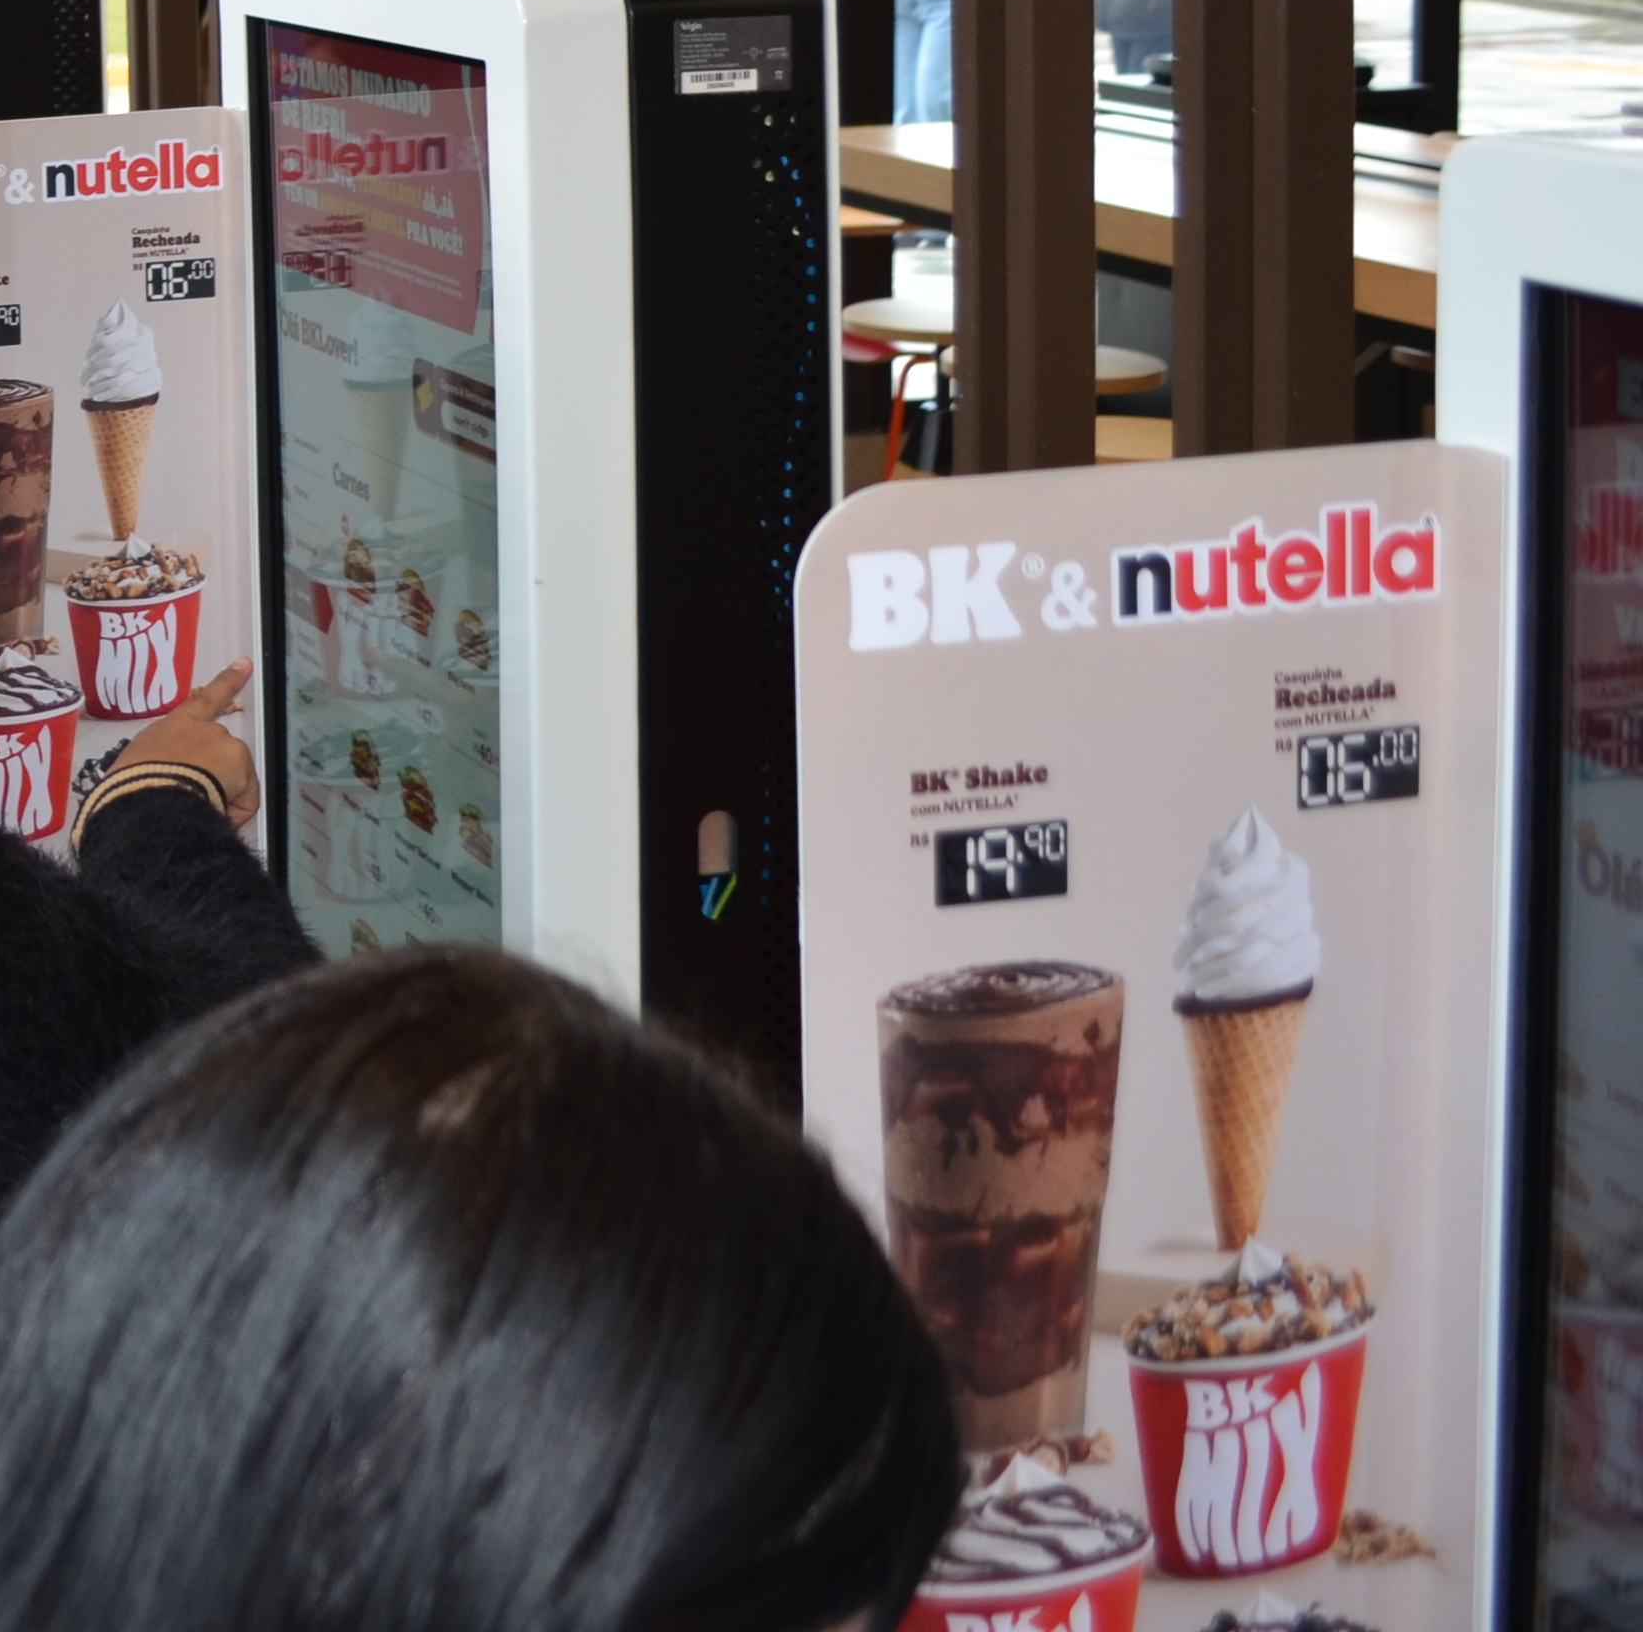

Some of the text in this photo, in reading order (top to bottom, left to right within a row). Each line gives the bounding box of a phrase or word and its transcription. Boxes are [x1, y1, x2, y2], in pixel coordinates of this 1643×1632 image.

[280, 53, 432, 118] ESTAMOS MUDANDO
[4, 167, 35, 206] &
[45, 141, 221, 200] nutella
[131, 232, 202, 249] Recheada
[147, 260, 214, 300] 06.00
[332, 463, 370, 501] Carnes
[847, 507, 1436, 652] BK & nutella
[98, 610, 154, 639] BK
[95, 602, 179, 714] MIX
[1273, 667, 1344, 684] Casquinha
[1274, 678, 1397, 710] Recheada
[1275, 716, 1303, 729] com
[964, 762, 1049, 789] Shake
[1275, 728, 1418, 808] R$ 06.00
[911, 803, 941, 816] com
[911, 824, 1066, 897] R$ 19.90
[1184, 1374, 1281, 1432] BK
[1175, 1359, 1322, 1567] MIX
